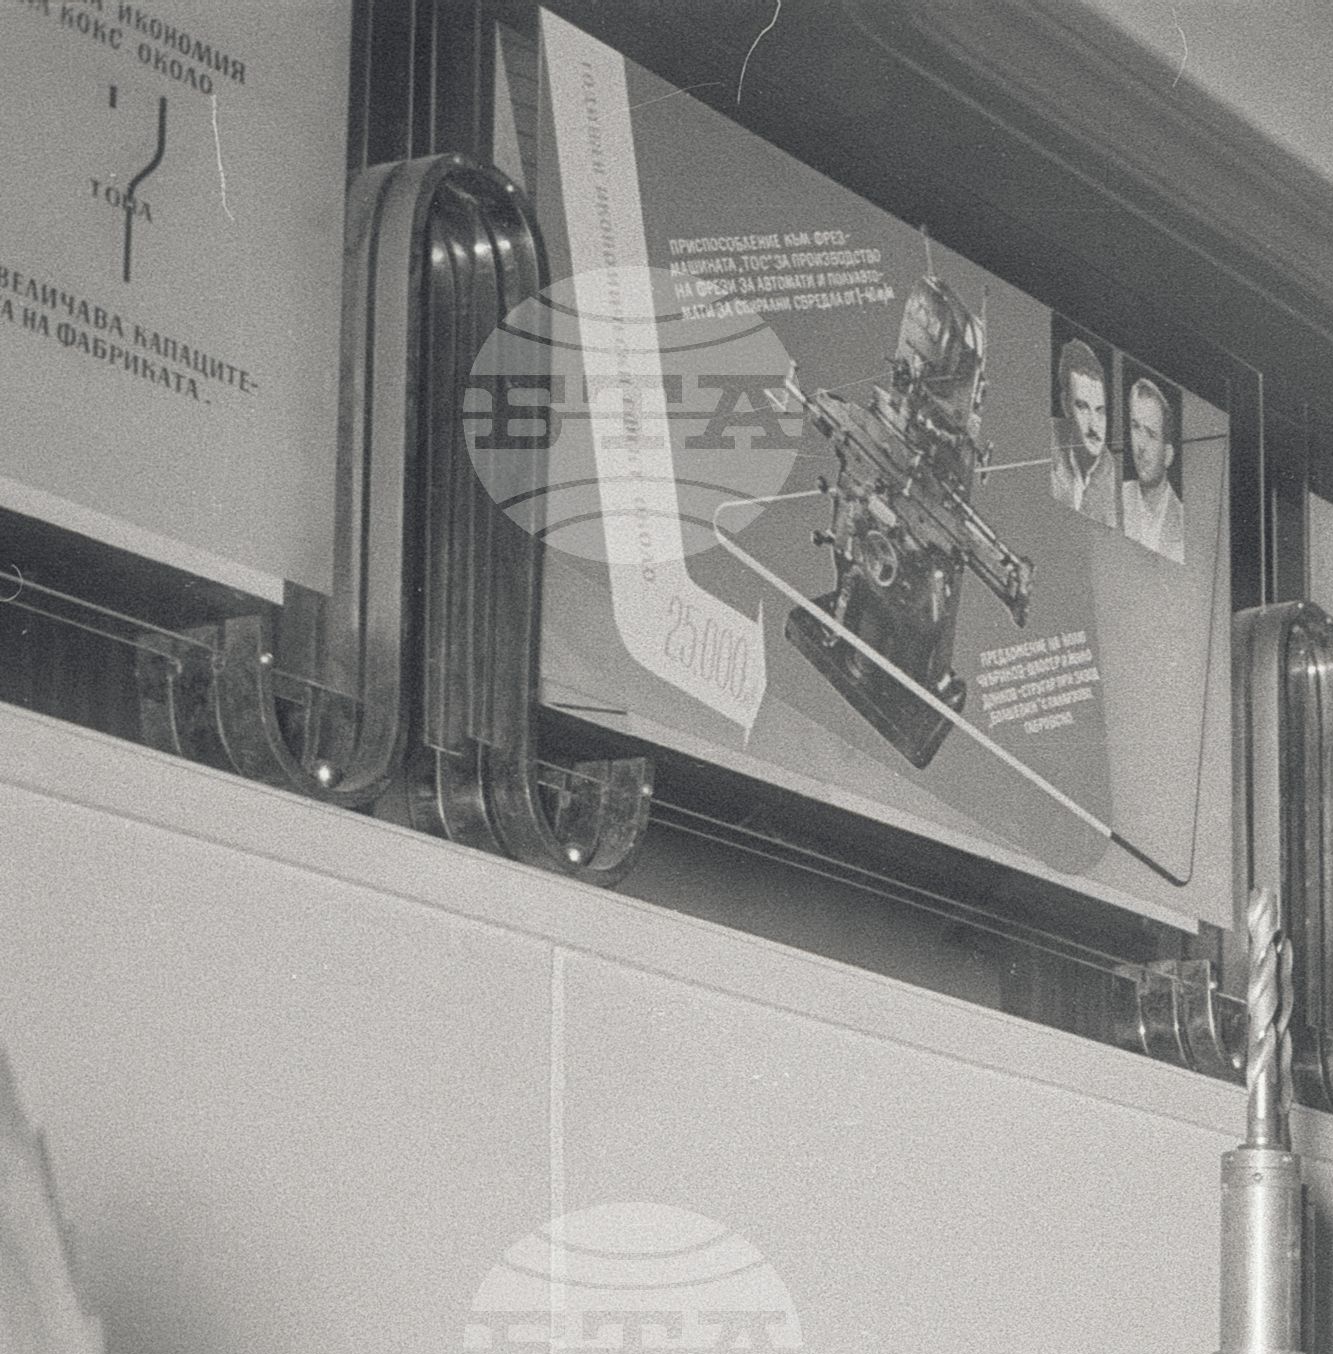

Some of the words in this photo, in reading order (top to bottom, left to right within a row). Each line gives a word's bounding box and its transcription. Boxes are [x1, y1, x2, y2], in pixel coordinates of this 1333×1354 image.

[61, 5, 123, 50] КОКС
[138, 43, 214, 95] ОКОЛО
[118, 4, 246, 84] ИКОНОМИЯ
[23, 307, 50, 337] НА
[133, 325, 259, 394] КАПАЦИТЕ-
